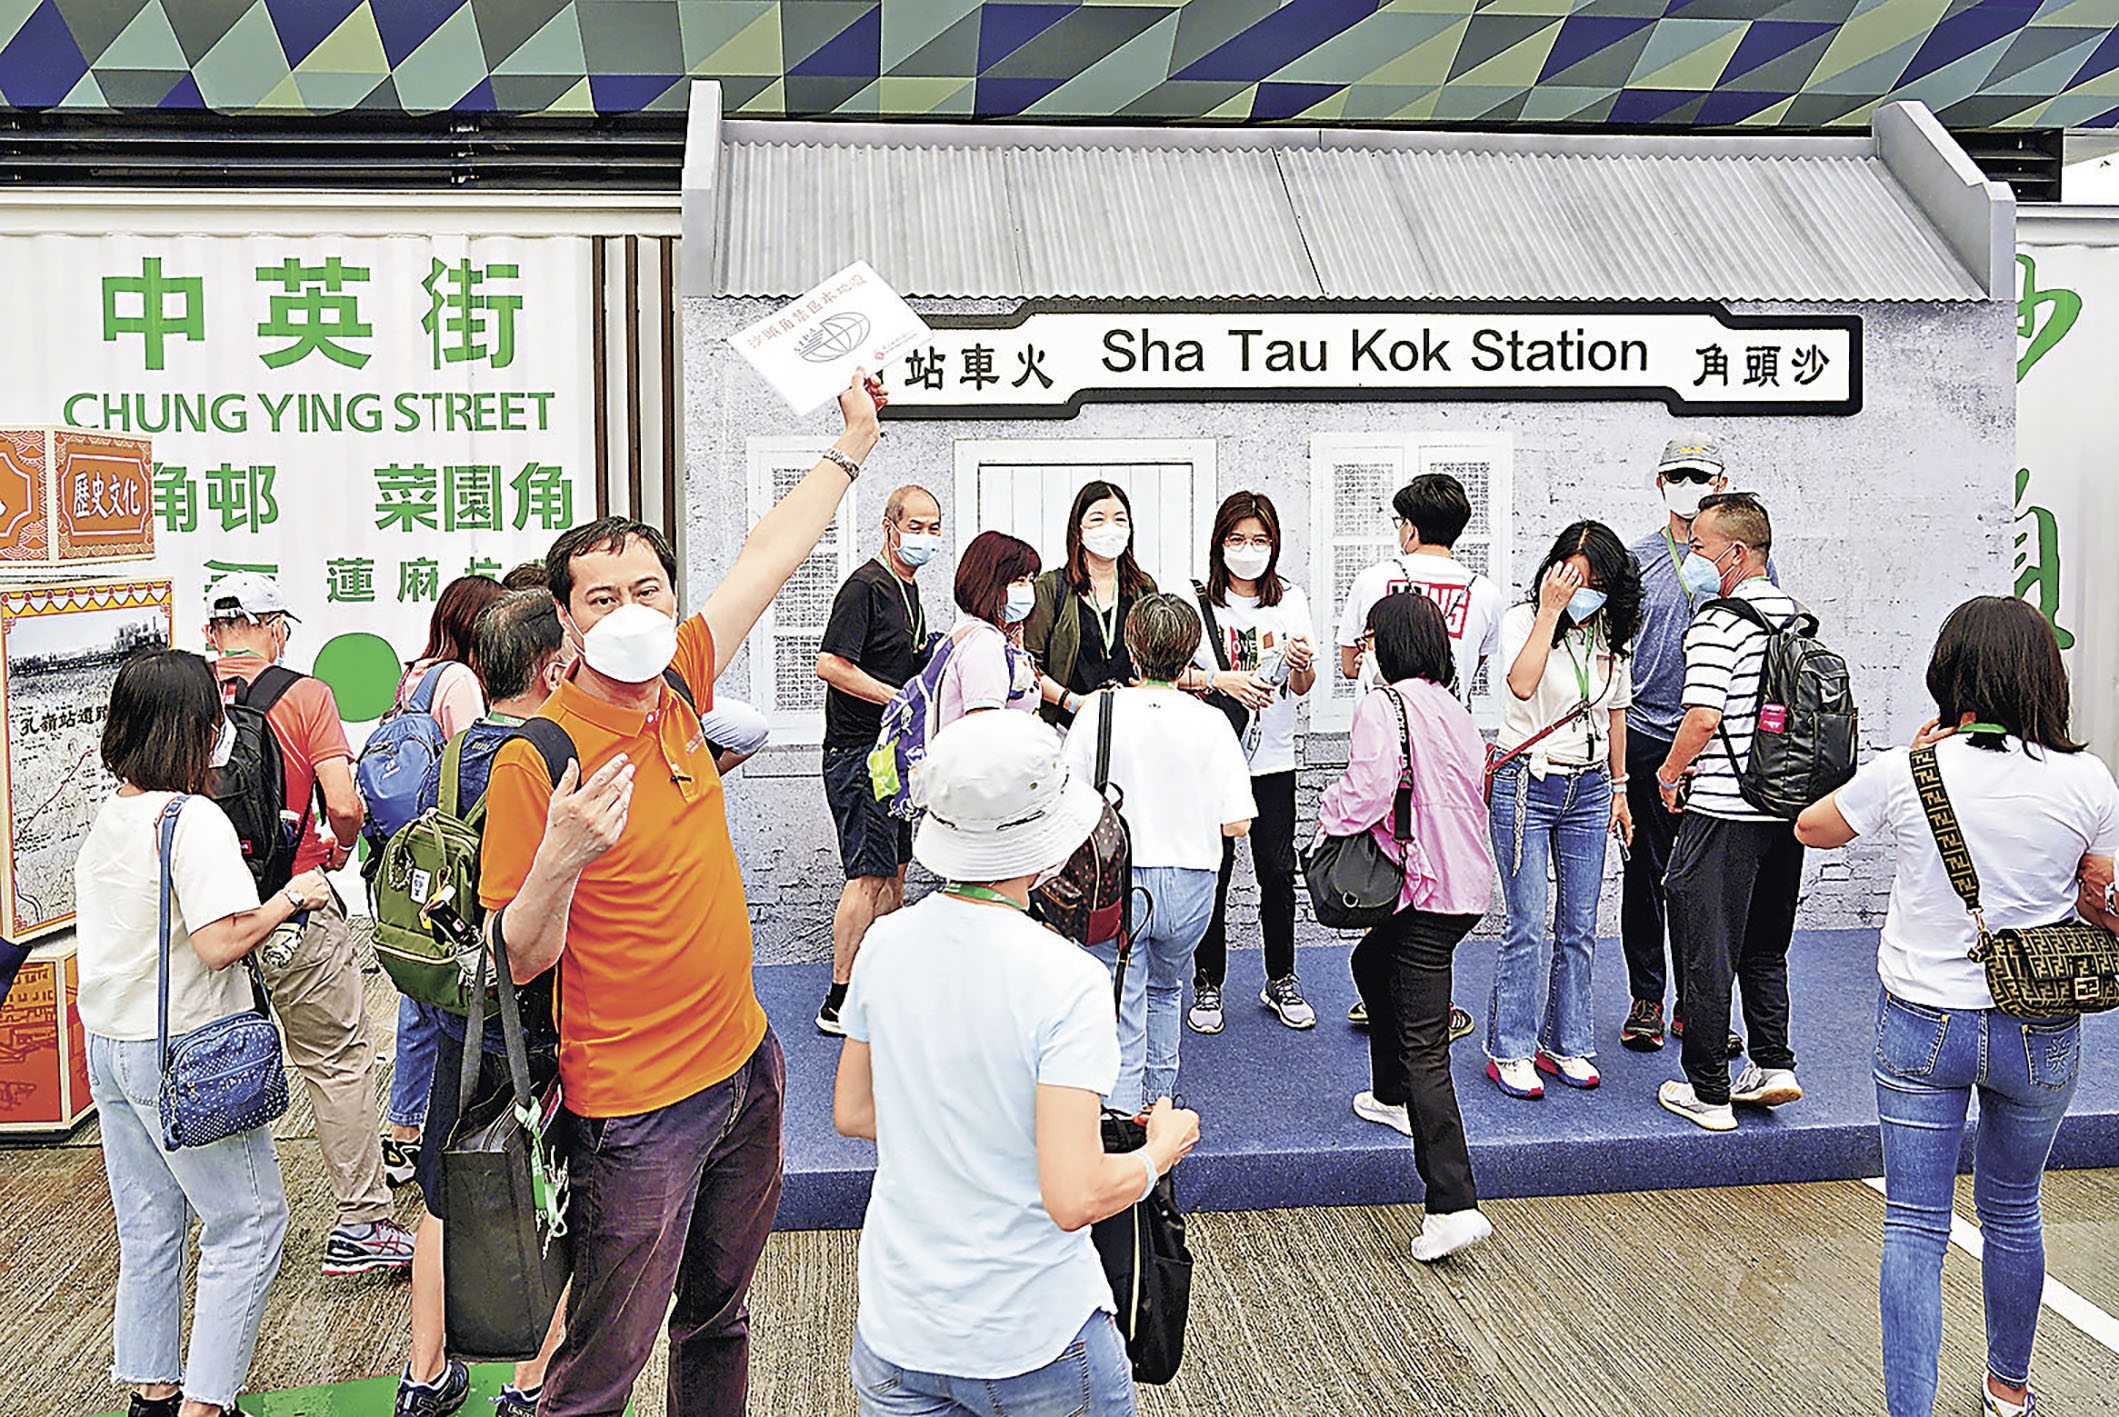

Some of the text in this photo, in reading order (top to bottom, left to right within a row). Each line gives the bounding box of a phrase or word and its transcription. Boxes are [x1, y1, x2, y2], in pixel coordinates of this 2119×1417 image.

[103, 257, 523, 370] 中英街
[1102, 328, 1648, 373] Sha Tau Kok Station
[63, 391, 555, 433] CHUNG YING STREET
[74, 472, 142, 519] 歷史文化
[374, 462, 573, 533] 菜園角
